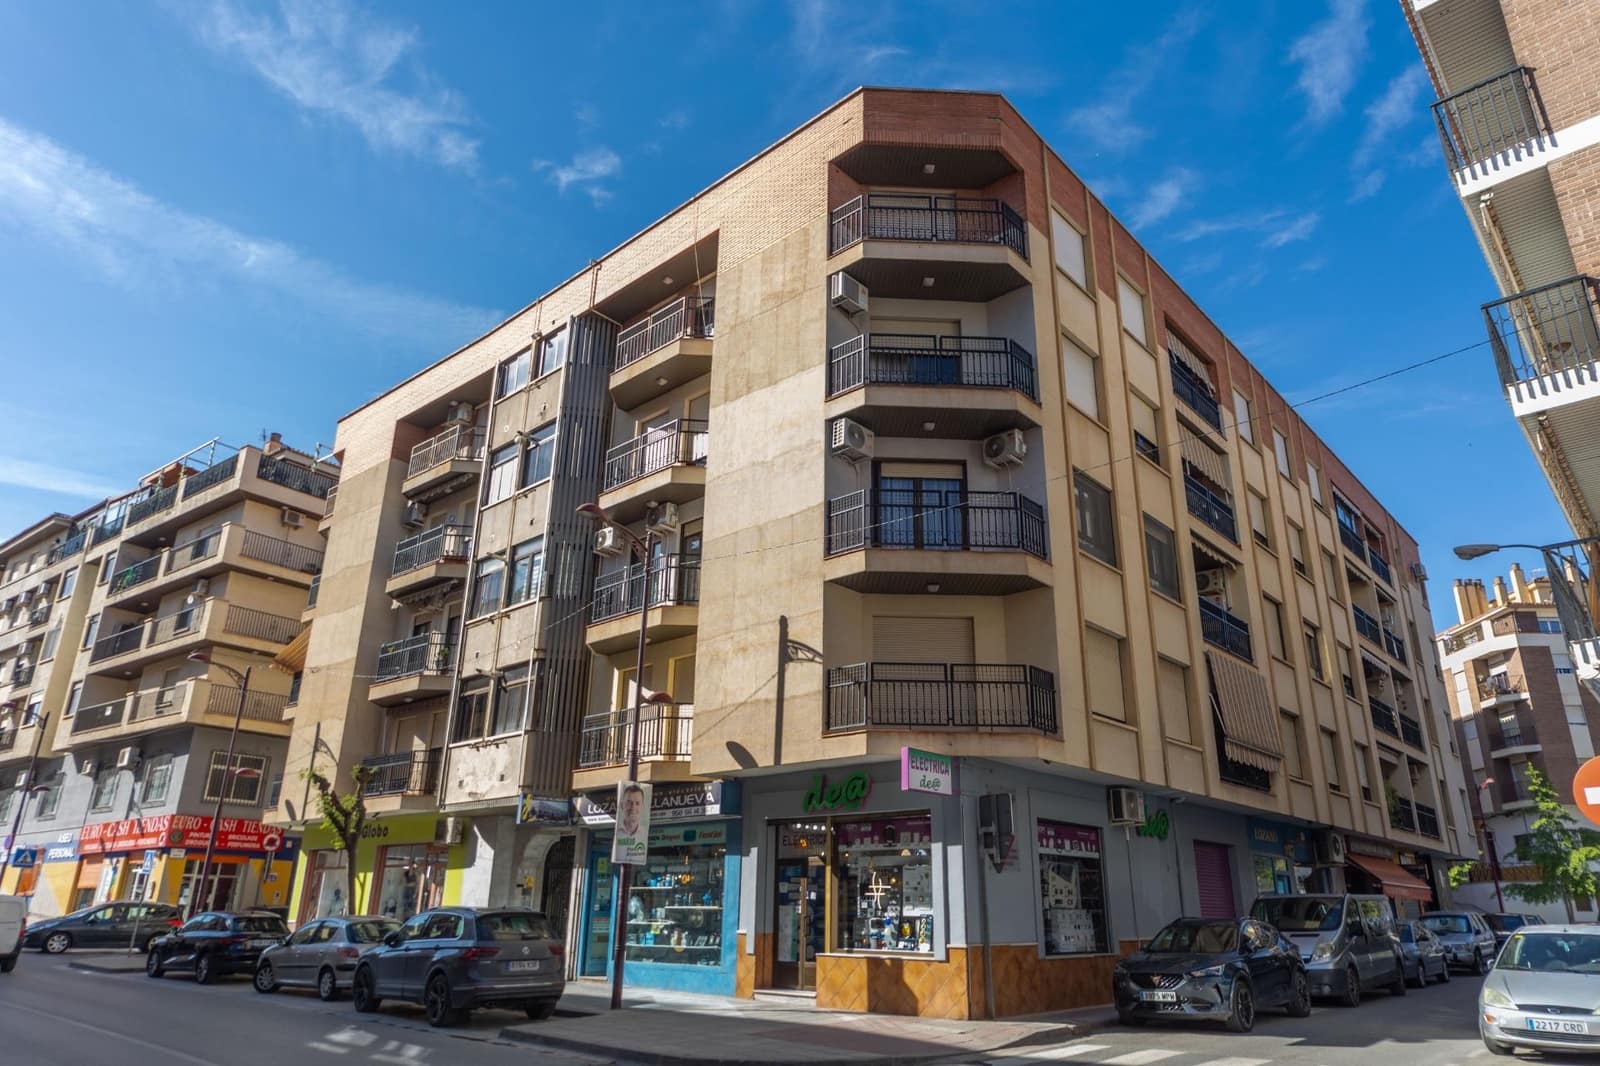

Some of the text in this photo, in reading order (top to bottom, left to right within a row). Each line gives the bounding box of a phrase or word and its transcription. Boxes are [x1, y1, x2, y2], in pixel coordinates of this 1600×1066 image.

[910, 753, 950, 777] ELECTRICA
[172, 815, 202, 829] EURO
[1535, 1020, 1584, 1033] 2217 CRD
